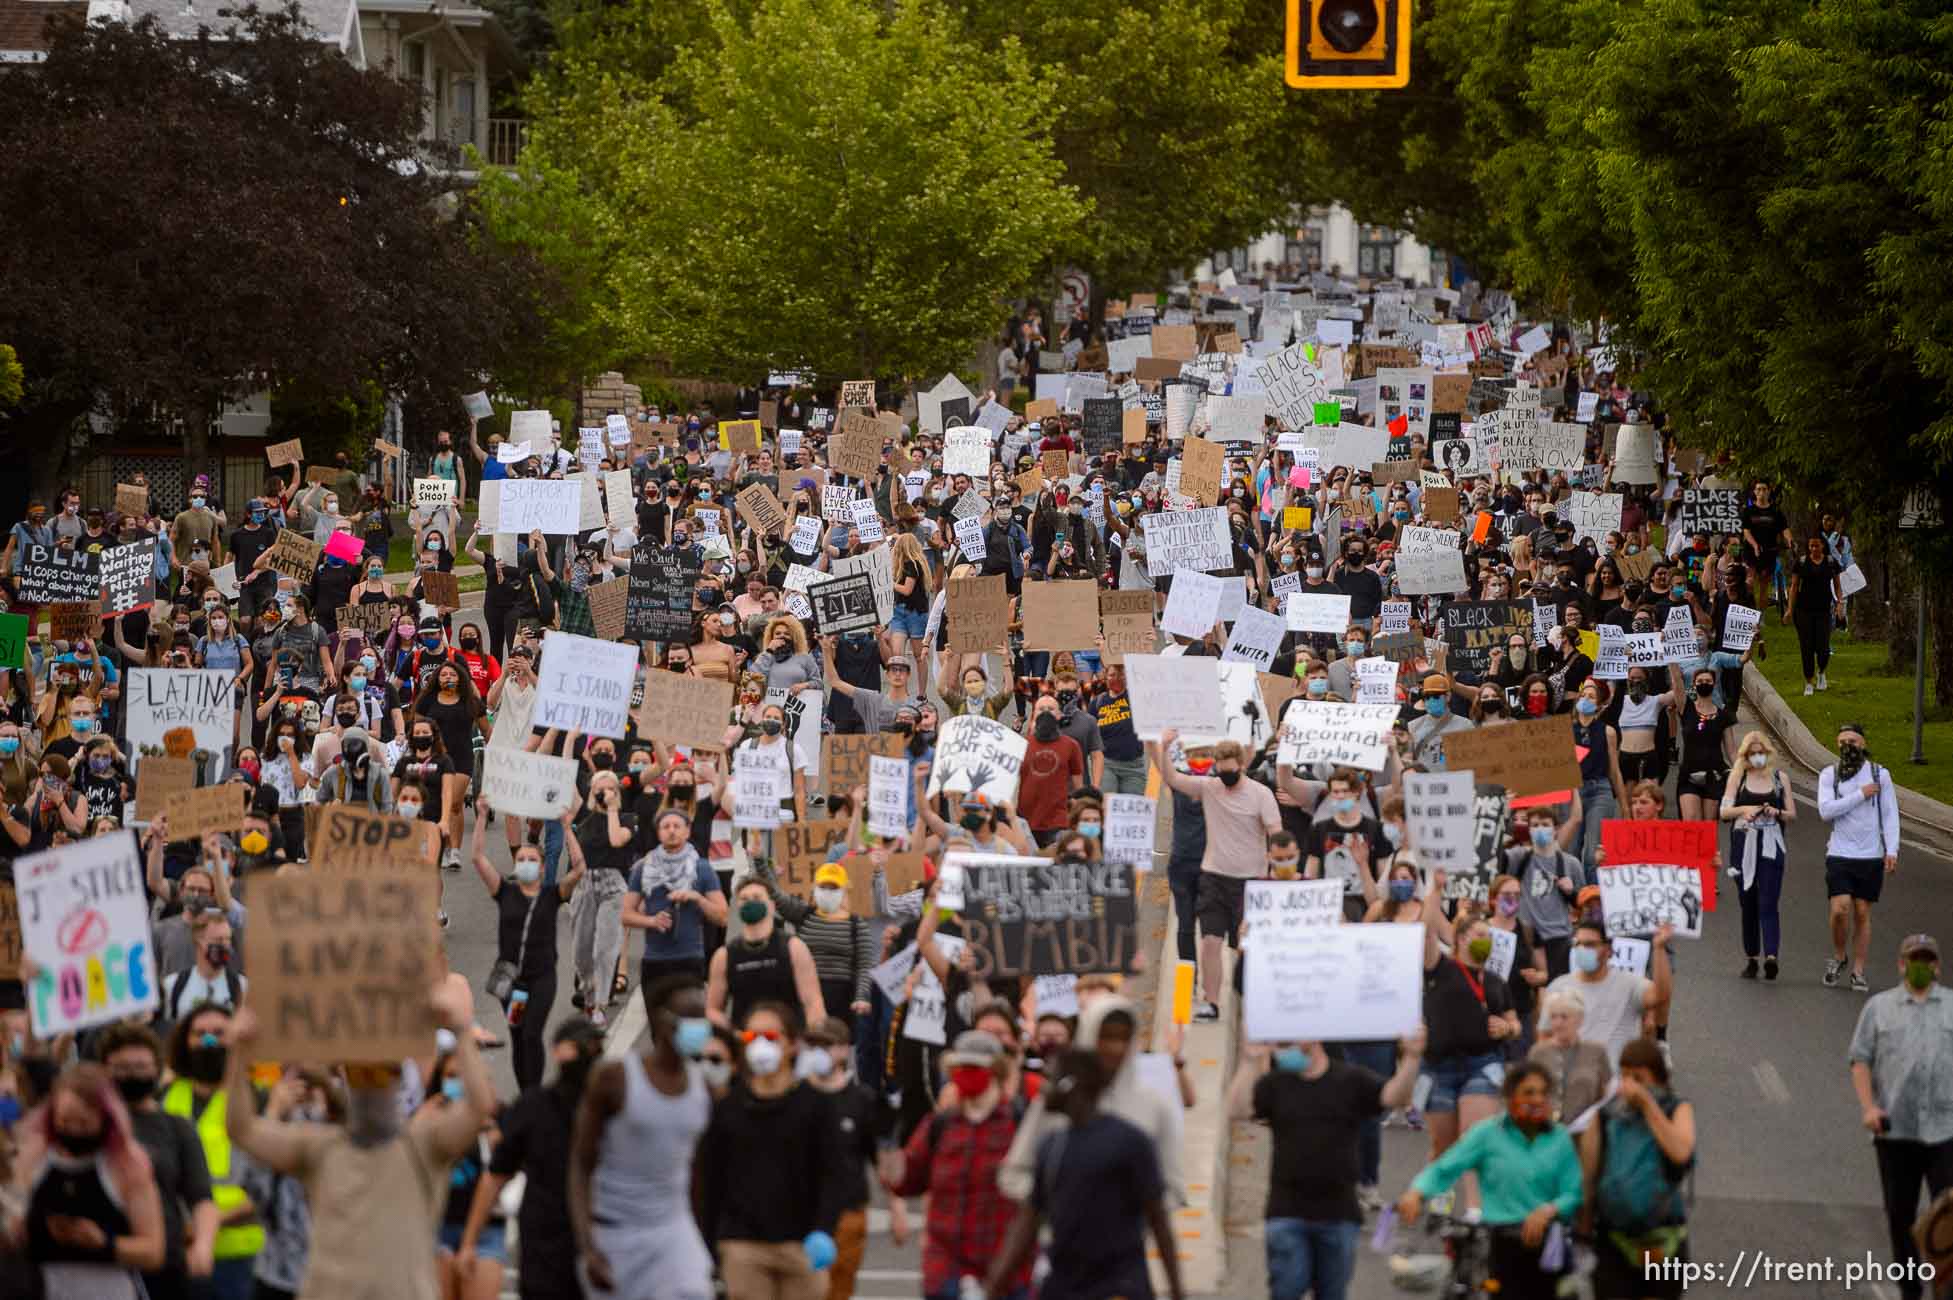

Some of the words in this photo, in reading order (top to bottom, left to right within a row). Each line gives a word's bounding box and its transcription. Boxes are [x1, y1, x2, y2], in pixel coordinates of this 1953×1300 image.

[1256, 345, 1309, 388] BLACK
[1268, 364, 1316, 408] LIVES
[1482, 413, 1500, 424] SAY
[1484, 436, 1500, 446] NAM
[1503, 437, 1534, 447] BLACK
[580, 451, 601, 460] MATTER
[1296, 449, 1317, 457] BLACK
[1298, 461, 1317, 469] LIVES
[1501, 458, 1538, 469] MATTER
[418, 491, 449, 501] SHOOT
[825, 487, 853, 500] BLACK
[1683, 489, 1740, 504] BLACK
[824, 499, 850, 510] LIVES
[852, 502, 874, 511] BLACK
[1571, 496, 1619, 509] BLACK
[697, 511, 718, 520] BLACK
[744, 490, 782, 530] ENOUGH!
[1682, 505, 1739, 518] LIVES
[796, 519, 819, 527] BLACK
[858, 514, 876, 525] LIVES
[956, 518, 979, 531] BLACK
[1157, 509, 1203, 528] UNDERSTAND
[1202, 508, 1219, 520] THAT
[1571, 511, 1619, 529] LIVES
[1682, 518, 1743, 534] MATTER
[796, 531, 815, 541] LIVES
[960, 533, 980, 546] LIVES
[1147, 531, 1161, 549] I
[1187, 522, 1217, 544] NEVER
[1407, 527, 1432, 543] YOUR
[1432, 530, 1460, 549] SILENCE
[101, 541, 140, 562] NOT
[279, 533, 315, 556] Black
[790, 541, 815, 551] MATTER
[31, 544, 89, 569] BLM
[633, 548, 649, 564] We
[1203, 554, 1233, 570] STAND
[24, 566, 32, 576] 4
[99, 553, 154, 575] Waiting
[268, 554, 313, 584] MATTER
[99, 571, 126, 586] for
[126, 564, 152, 577] the
[1273, 575, 1297, 589] BLACK
[48, 581, 74, 593] about
[110, 574, 150, 592] NEXT
[112, 590, 139, 611] #
[790, 598, 803, 611] VES
[338, 603, 386, 622] JUSTICE
[1383, 604, 1409, 614] BLACK
[1538, 607, 1554, 617] ACK
[1731, 607, 1758, 617] BLACK
[1384, 620, 1407, 629] LIVES
[1448, 607, 1495, 628] BLACK
[1730, 620, 1753, 630] LIVES
[1666, 629, 1690, 640] LIVES
[1232, 642, 1270, 663] MATTER
[1602, 647, 1624, 657] LIVES
[1627, 651, 1660, 663] HOOT
[1663, 644, 1697, 657] MATTER
[1361, 664, 1393, 674] BLACK
[1596, 662, 1628, 673] MATTER
[554, 673, 567, 695] I
[572, 676, 622, 701] STAND
[1362, 685, 1390, 696] LIVES
[544, 700, 588, 729] WITH
[590, 705, 621, 731] YOU
[952, 716, 1004, 741] HANDS
[955, 729, 981, 742] UP
[832, 735, 890, 756] BLACK
[1293, 742, 1362, 763] Taylor
[740, 756, 776, 769] BLACK
[831, 757, 867, 777] LIV
[873, 763, 904, 777] LACK
[743, 782, 773, 795] LIVES
[736, 805, 780, 817] MATTER
[1112, 800, 1153, 814] BLACK
[328, 813, 412, 848] STOP
[1111, 825, 1147, 839] LIVES
[1103, 850, 1152, 864] MATTER
[1604, 866, 1700, 887] JUSTICE
[264, 878, 418, 924] BLACK
[1249, 890, 1273, 910] NO
[1280, 887, 1339, 910] JUSTICE
[1632, 887, 1682, 906] FOR
[1608, 906, 1675, 932] GEORGE
[277, 936, 426, 979] LIVES
